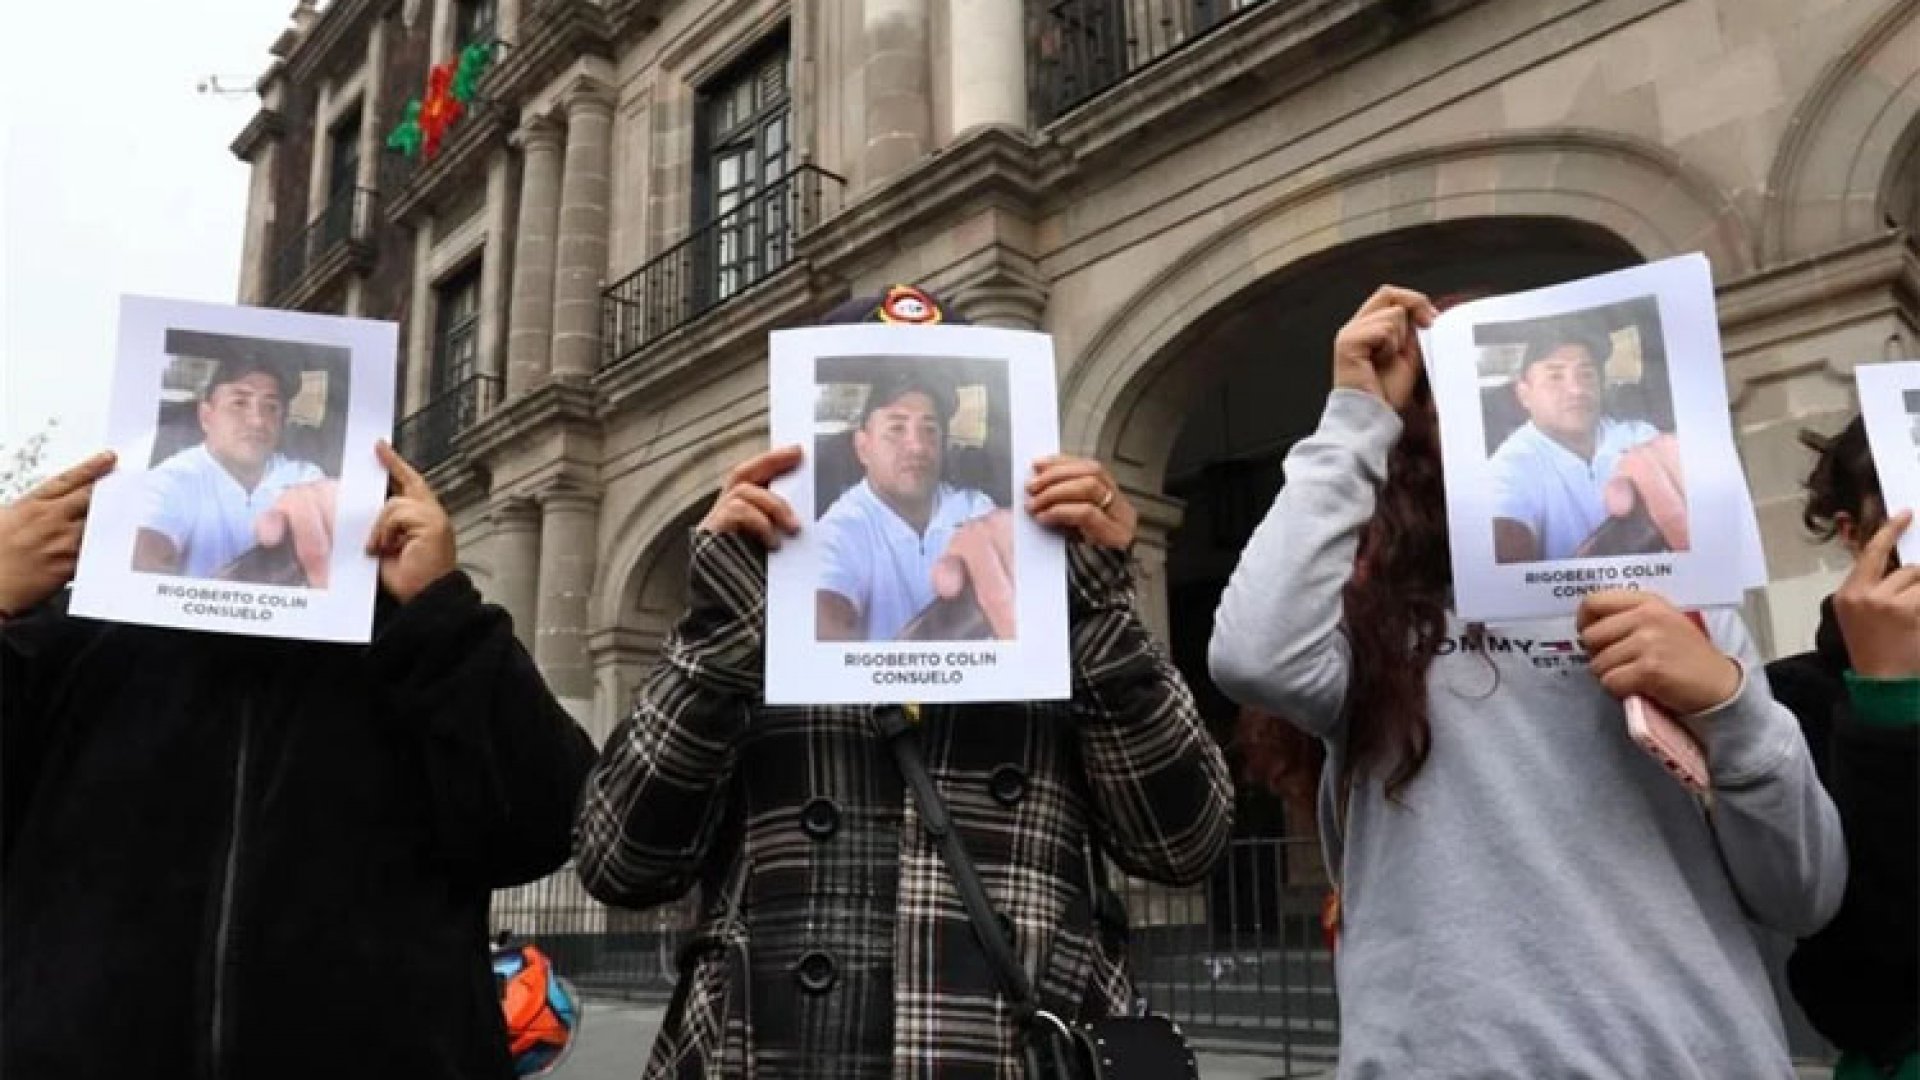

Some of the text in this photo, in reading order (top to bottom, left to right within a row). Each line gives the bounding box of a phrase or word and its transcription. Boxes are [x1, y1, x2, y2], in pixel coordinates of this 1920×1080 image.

[1525, 563, 1673, 583] RIGOBERTO COLIN
[157, 584, 308, 609] RIGOBERTO COLIN
[182, 601, 273, 620] CONSUELO
[1424, 635, 1533, 654] OMMY
[844, 652, 997, 667] RIGOBERTO COLIN
[872, 670, 963, 684] CONSUELO
